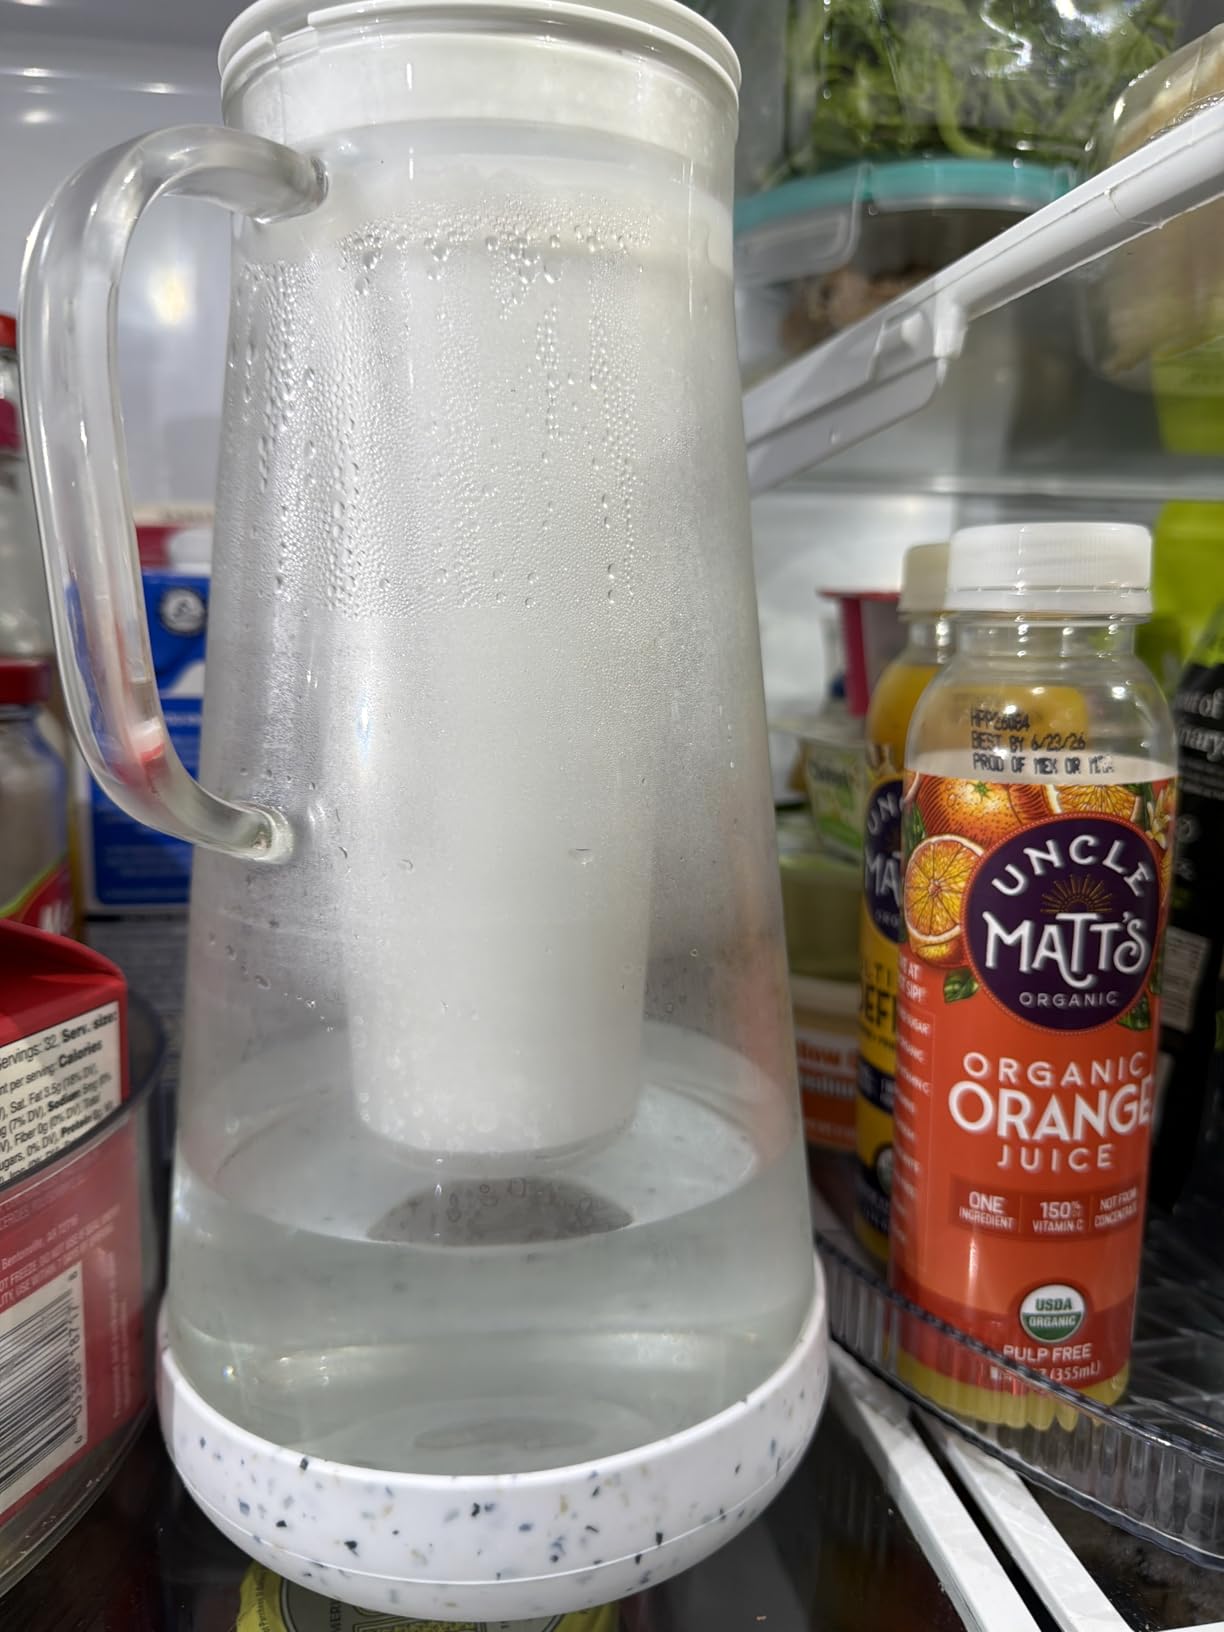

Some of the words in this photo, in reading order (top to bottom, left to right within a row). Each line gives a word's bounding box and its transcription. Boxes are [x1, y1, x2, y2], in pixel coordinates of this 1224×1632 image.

[1199, 687, 1224, 719] of
[971, 732, 1001, 750] BEST
[1009, 735, 1025, 752] BY
[1011, 756, 1026, 772] OF
[1034, 757, 1058, 774] MEX
[1065, 757, 1081, 774] OR
[991, 834, 1152, 897] UNCLE
[981, 911, 1150, 988] MATT'S
[1018, 991, 1119, 1008] ORGANIC
[0, 1045, 41, 1071] ervings:
[62, 1025, 91, 1043] Serv.
[9, 1077, 24, 1094] per
[59, 1040, 103, 1068] Calories
[962, 1050, 1147, 1088] ORGANIC
[28, 1090, 43, 1104] Fat
[948, 1075, 1155, 1143] ORANGE
[14, 1128, 36, 1146] Fiber
[996, 1143, 1114, 1173] JUICE
[968, 1191, 1006, 1214] ONE
[1099, 1198, 1117, 1212] NOT
[1118, 1187, 1138, 1205] FROM
[958, 1206, 1015, 1231] INGREDIENT
[1032, 1220, 1072, 1234] VITAMIN
[1075, 1219, 1084, 1232] C
[1034, 1298, 1073, 1312] USDA
[1029, 1313, 1077, 1328] ORGANIC
[1003, 1344, 1048, 1363] PULP
[1052, 1343, 1093, 1362] FREE
[1049, 1360, 1101, 1382] (355mL)
